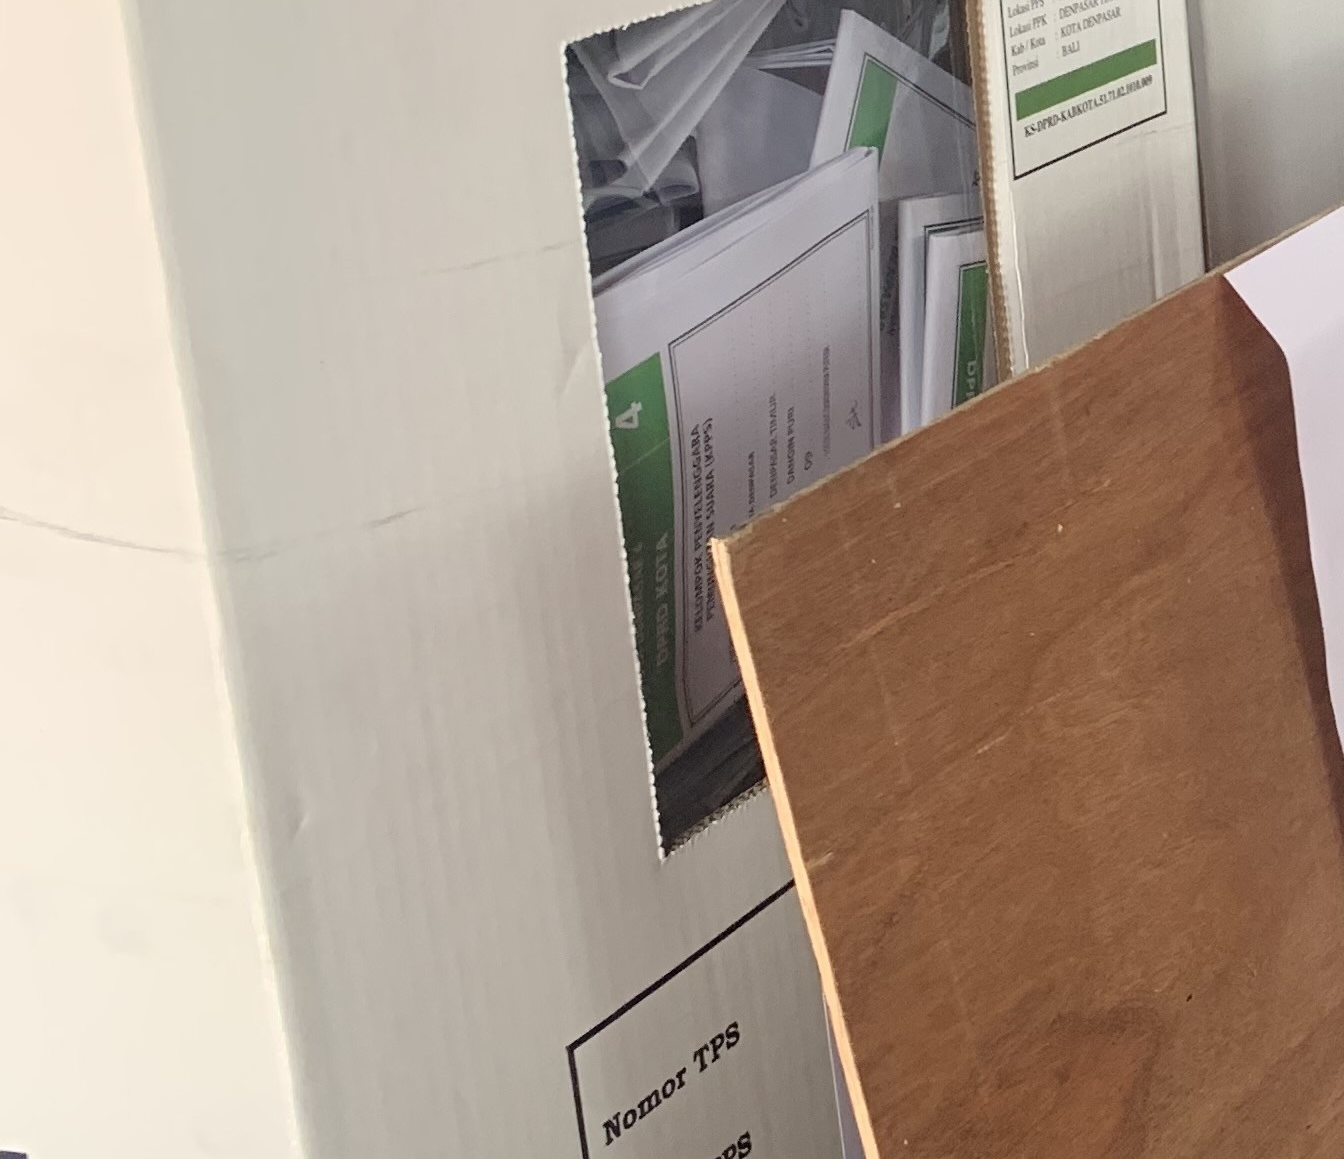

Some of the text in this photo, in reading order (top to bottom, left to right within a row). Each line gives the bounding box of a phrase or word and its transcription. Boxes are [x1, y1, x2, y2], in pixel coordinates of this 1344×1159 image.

[1008, 3, 1030, 18] Lokasi
[1060, 22, 1081, 38] KOTA
[1083, 6, 1121, 30] DENPASAR
[1062, 41, 1080, 57] BALI
[615, 401, 642, 429] 4
[769, 393, 777, 434] TIMUR
[703, 418, 715, 468] (KPPS)
[787, 436, 795, 484] DANGIN
[706, 469, 715, 521] SUARA
[691, 424, 702, 633] KELOMPOK PENYELENGGARA
[656, 532, 668, 599] KOTA
[602, 1021, 740, 1146] Nomor TPS
[715, 1131, 752, 1159] PS
